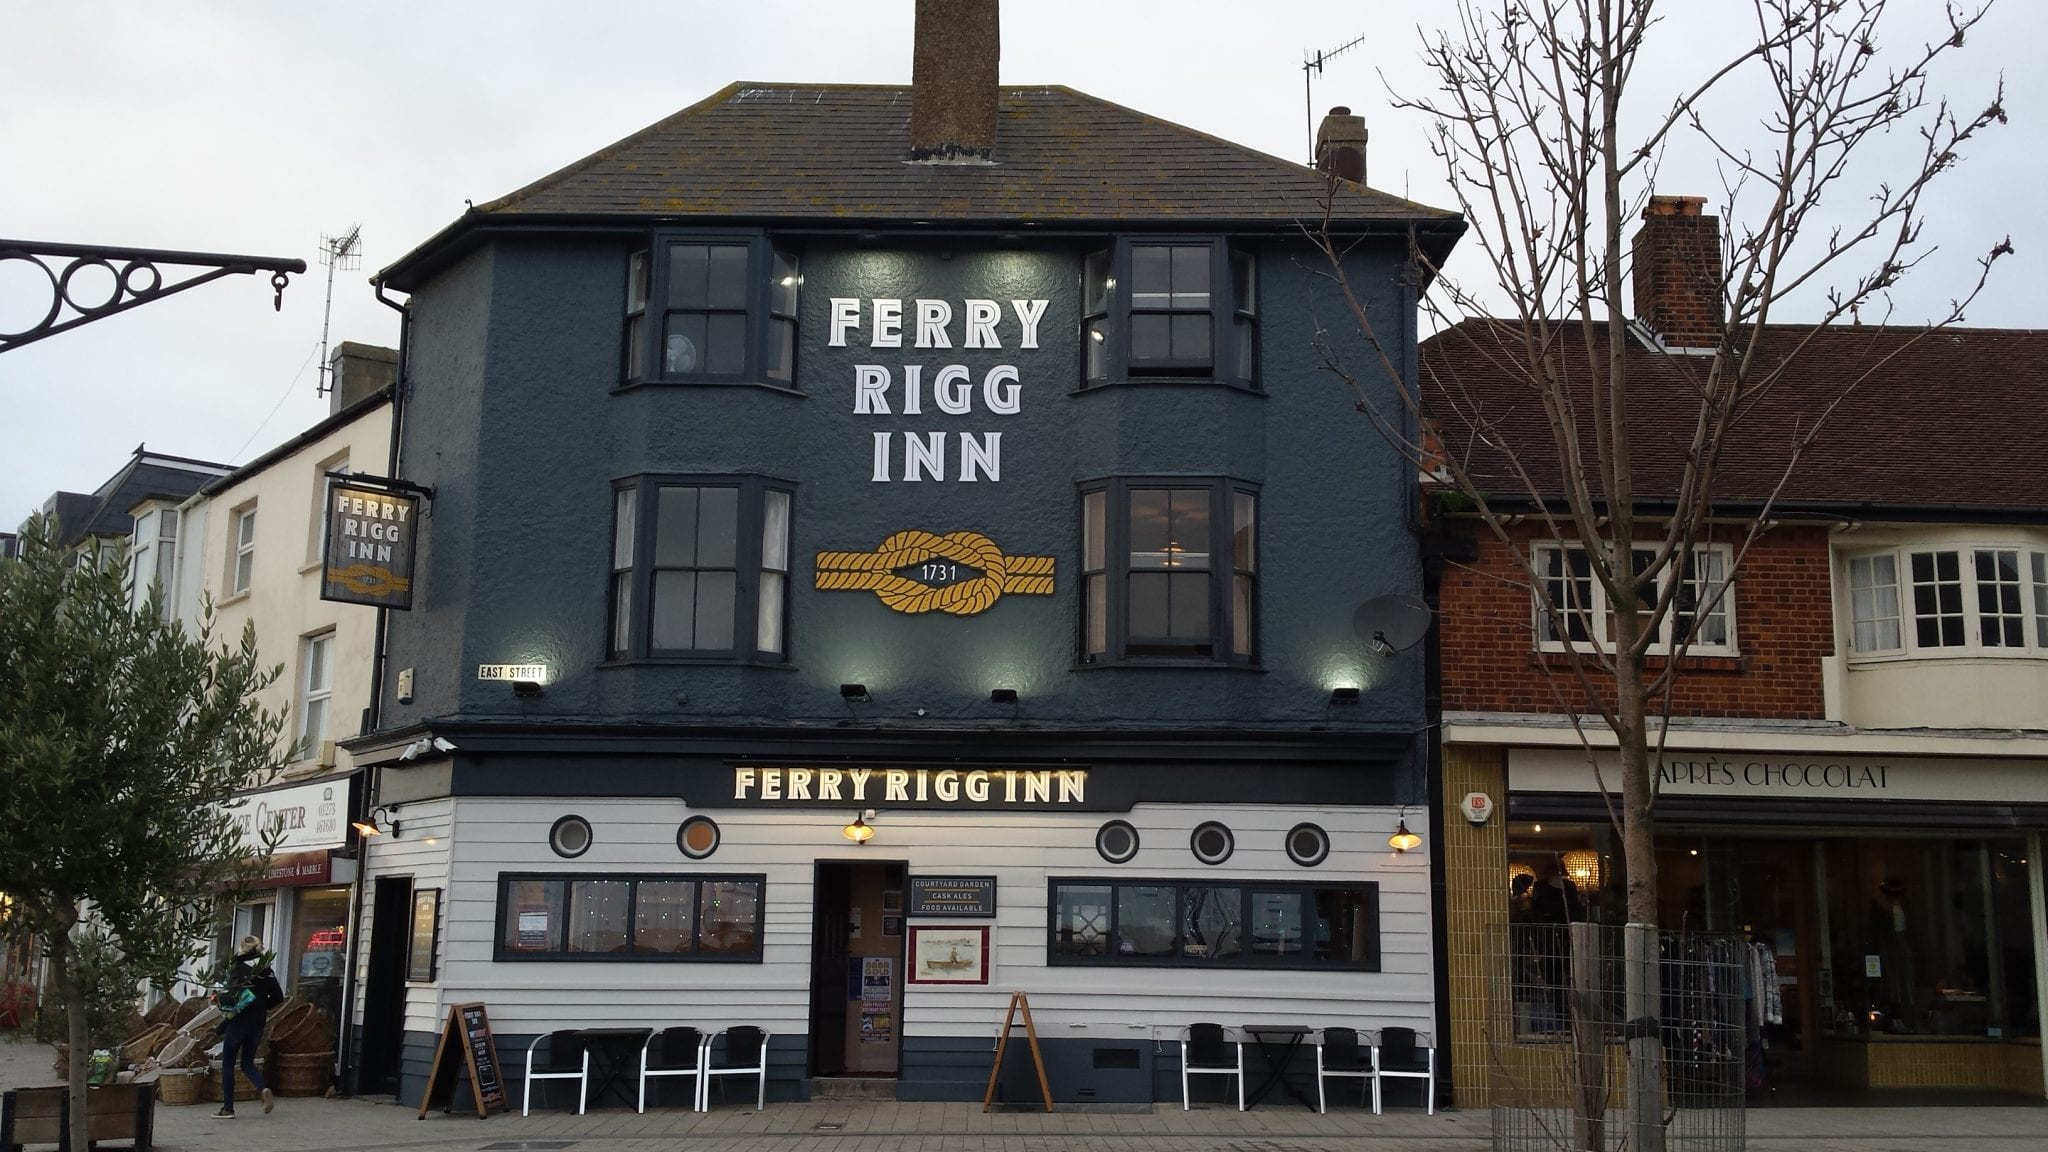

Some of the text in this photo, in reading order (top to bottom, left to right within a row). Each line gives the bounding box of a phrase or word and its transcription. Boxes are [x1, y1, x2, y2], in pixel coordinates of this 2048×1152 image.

[828, 297, 1050, 349] FERRY
[853, 364, 1022, 415] RIGG
[871, 431, 1003, 482] INN
[338, 495, 409, 522] FERRY
[344, 518, 399, 542] RIGG
[349, 541, 391, 562] INN
[922, 564, 956, 580] 1731
[480, 666, 543, 678] EAST STREET
[734, 767, 1085, 803] FERRY RIGG INN
[1743, 762, 1890, 788] CHOCOLAT
[302, 864, 321, 875] MARBLE
[865, 968, 889, 976] GOLD
